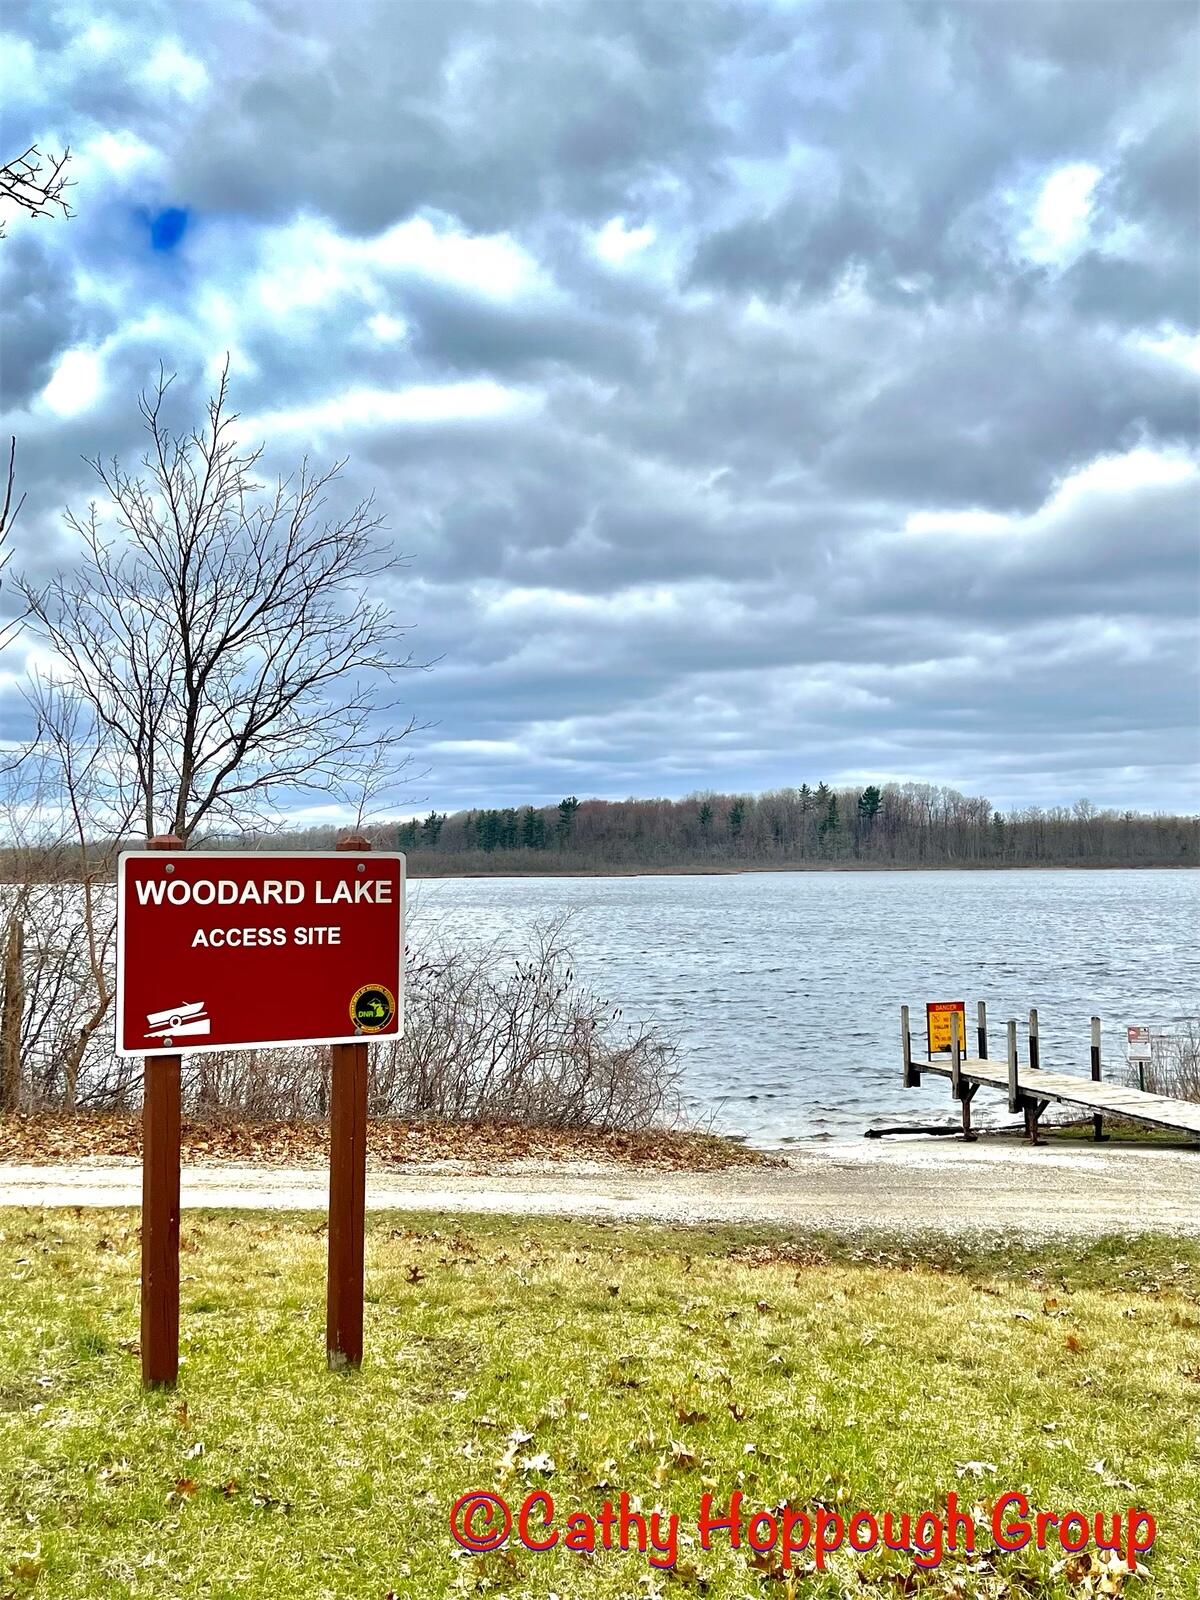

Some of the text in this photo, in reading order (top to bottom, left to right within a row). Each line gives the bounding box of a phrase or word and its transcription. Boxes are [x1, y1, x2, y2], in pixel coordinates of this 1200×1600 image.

[135, 880, 393, 905] WOODARD LAKE
[191, 926, 342, 948] ACCESS SITE
